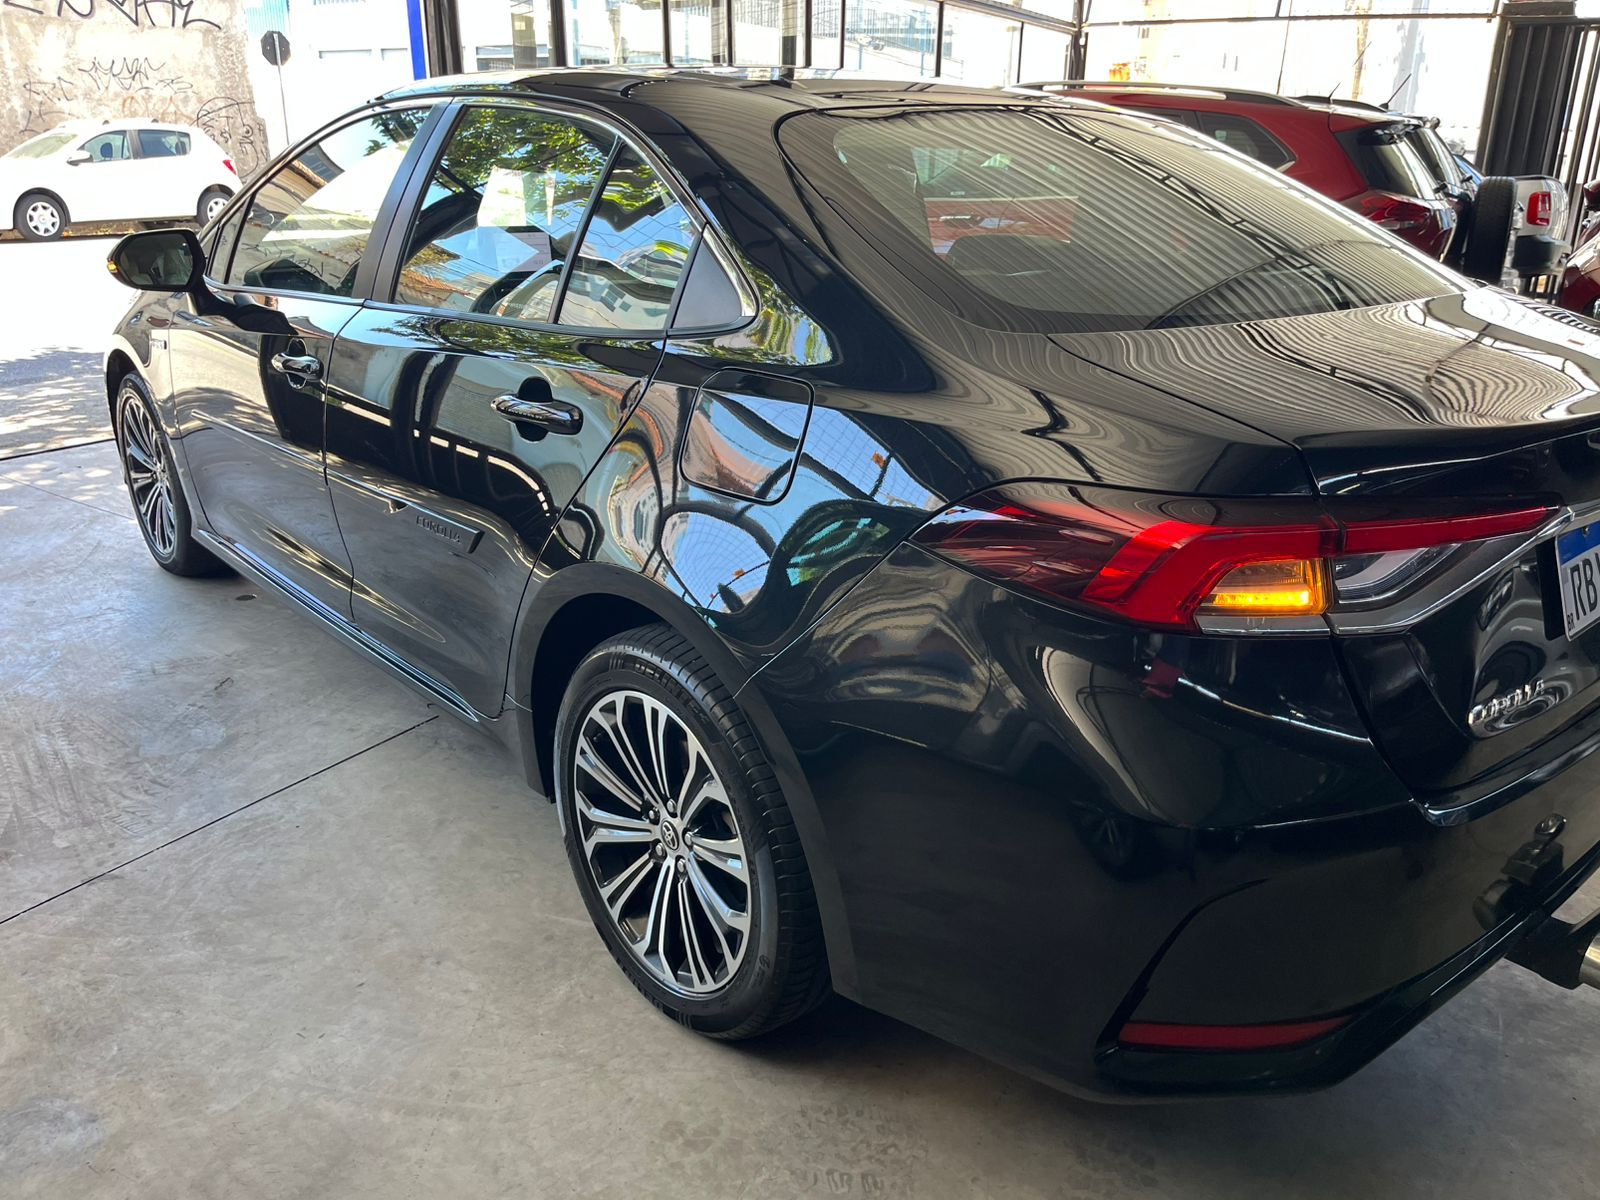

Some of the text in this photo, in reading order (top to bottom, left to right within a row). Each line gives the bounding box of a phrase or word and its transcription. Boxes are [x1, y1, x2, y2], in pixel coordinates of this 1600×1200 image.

[416, 515, 461, 543] COROLLA
[1570, 552, 1600, 621] RB
[1567, 612, 1575, 632] BR
